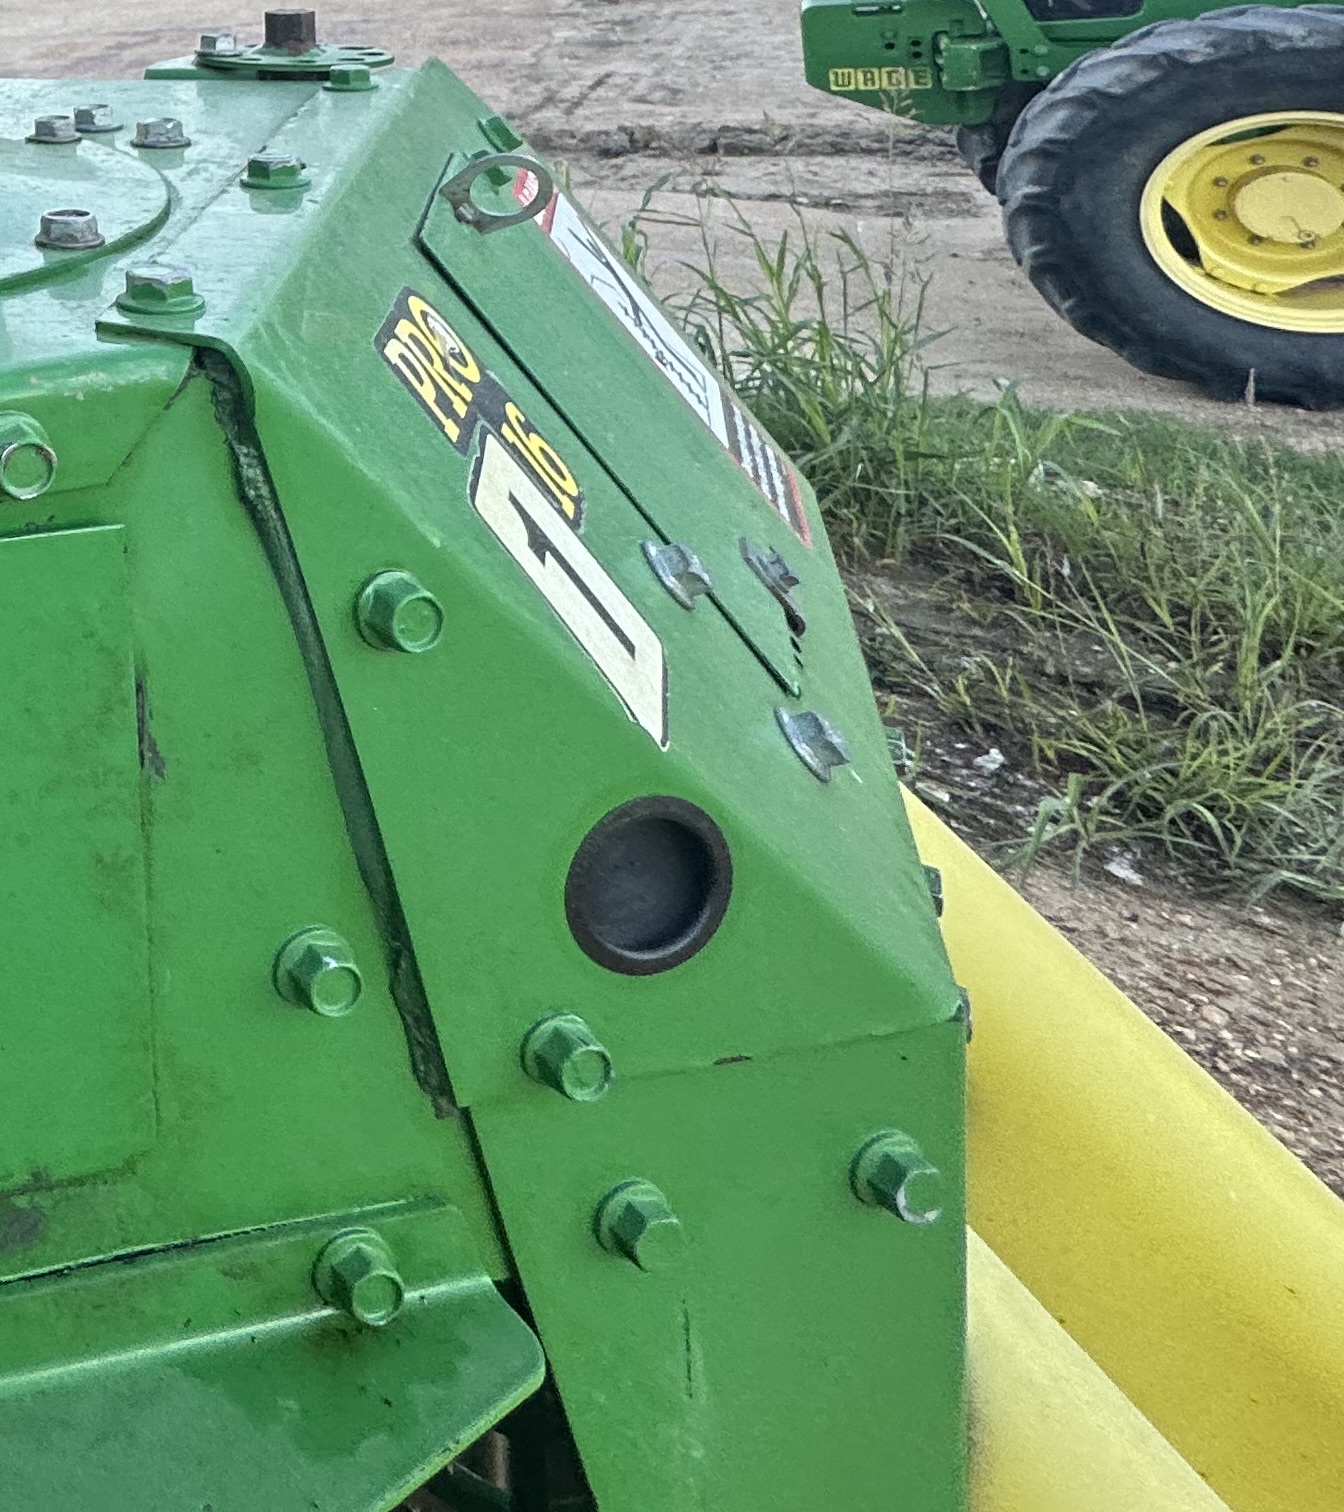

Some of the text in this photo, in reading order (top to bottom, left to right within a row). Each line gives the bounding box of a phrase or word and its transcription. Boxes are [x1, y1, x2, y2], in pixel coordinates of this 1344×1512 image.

[383, 295, 481, 444] PRO
[501, 401, 578, 520] 16
[508, 489, 636, 662] 1
